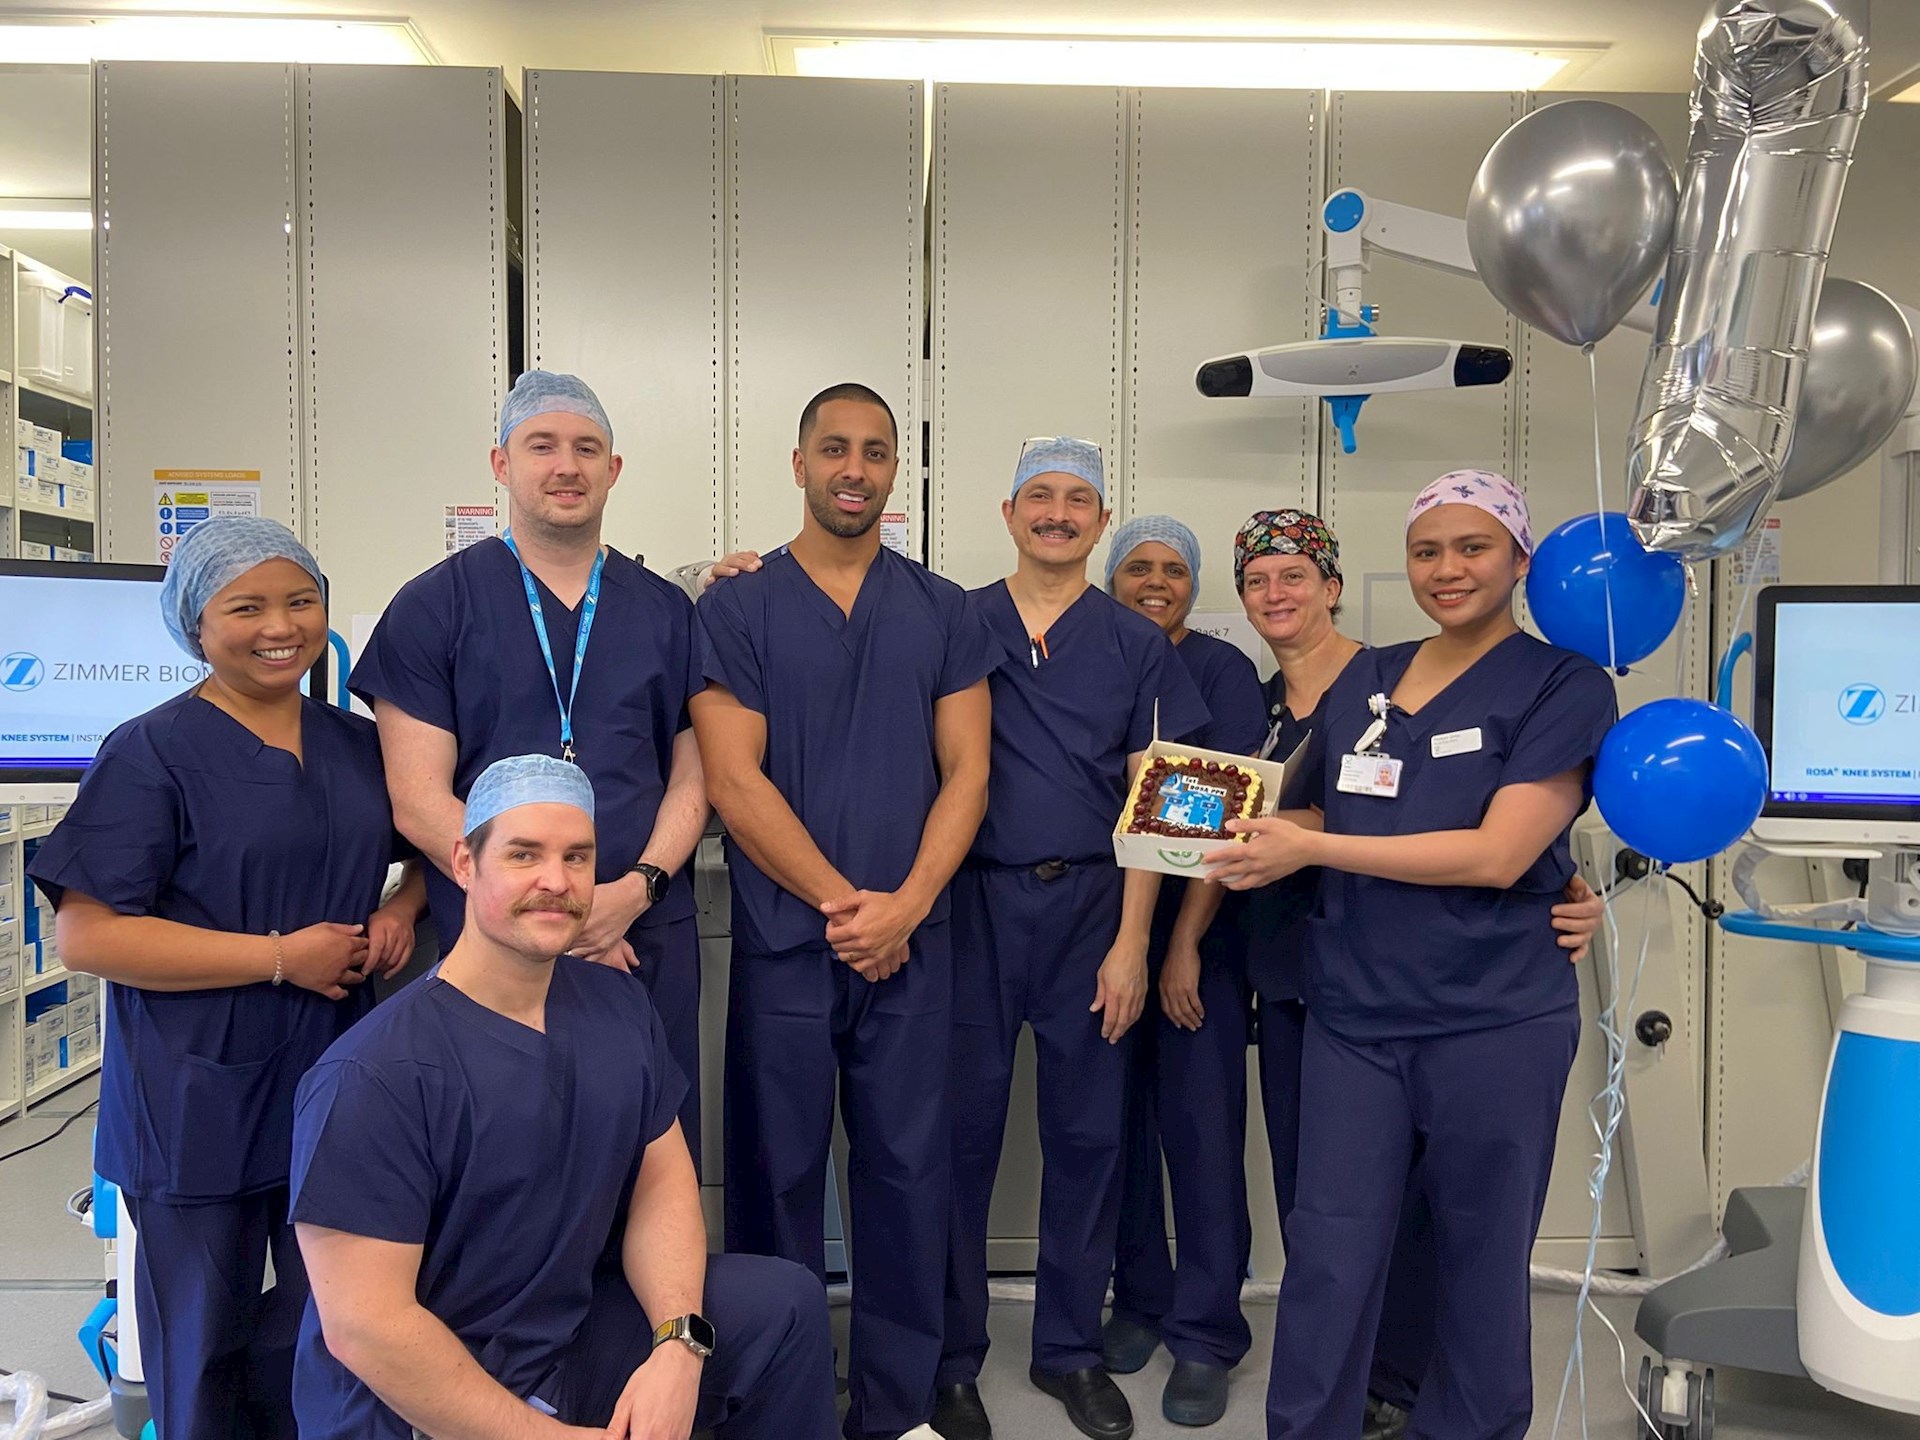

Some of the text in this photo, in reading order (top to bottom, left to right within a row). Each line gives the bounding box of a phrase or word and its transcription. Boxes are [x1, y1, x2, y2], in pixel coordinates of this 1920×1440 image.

[880, 514, 904, 522] RNING
[1222, 628, 1229, 637] 7
[53, 663, 150, 682] ZIMMER
[1, 734, 28, 742] KNEE
[30, 734, 70, 742] SYSTEM
[1842, 768, 1869, 778] KNEE
[1870, 769, 1911, 779] SYSTEM
[1190, 785, 1209, 793] ROSA
